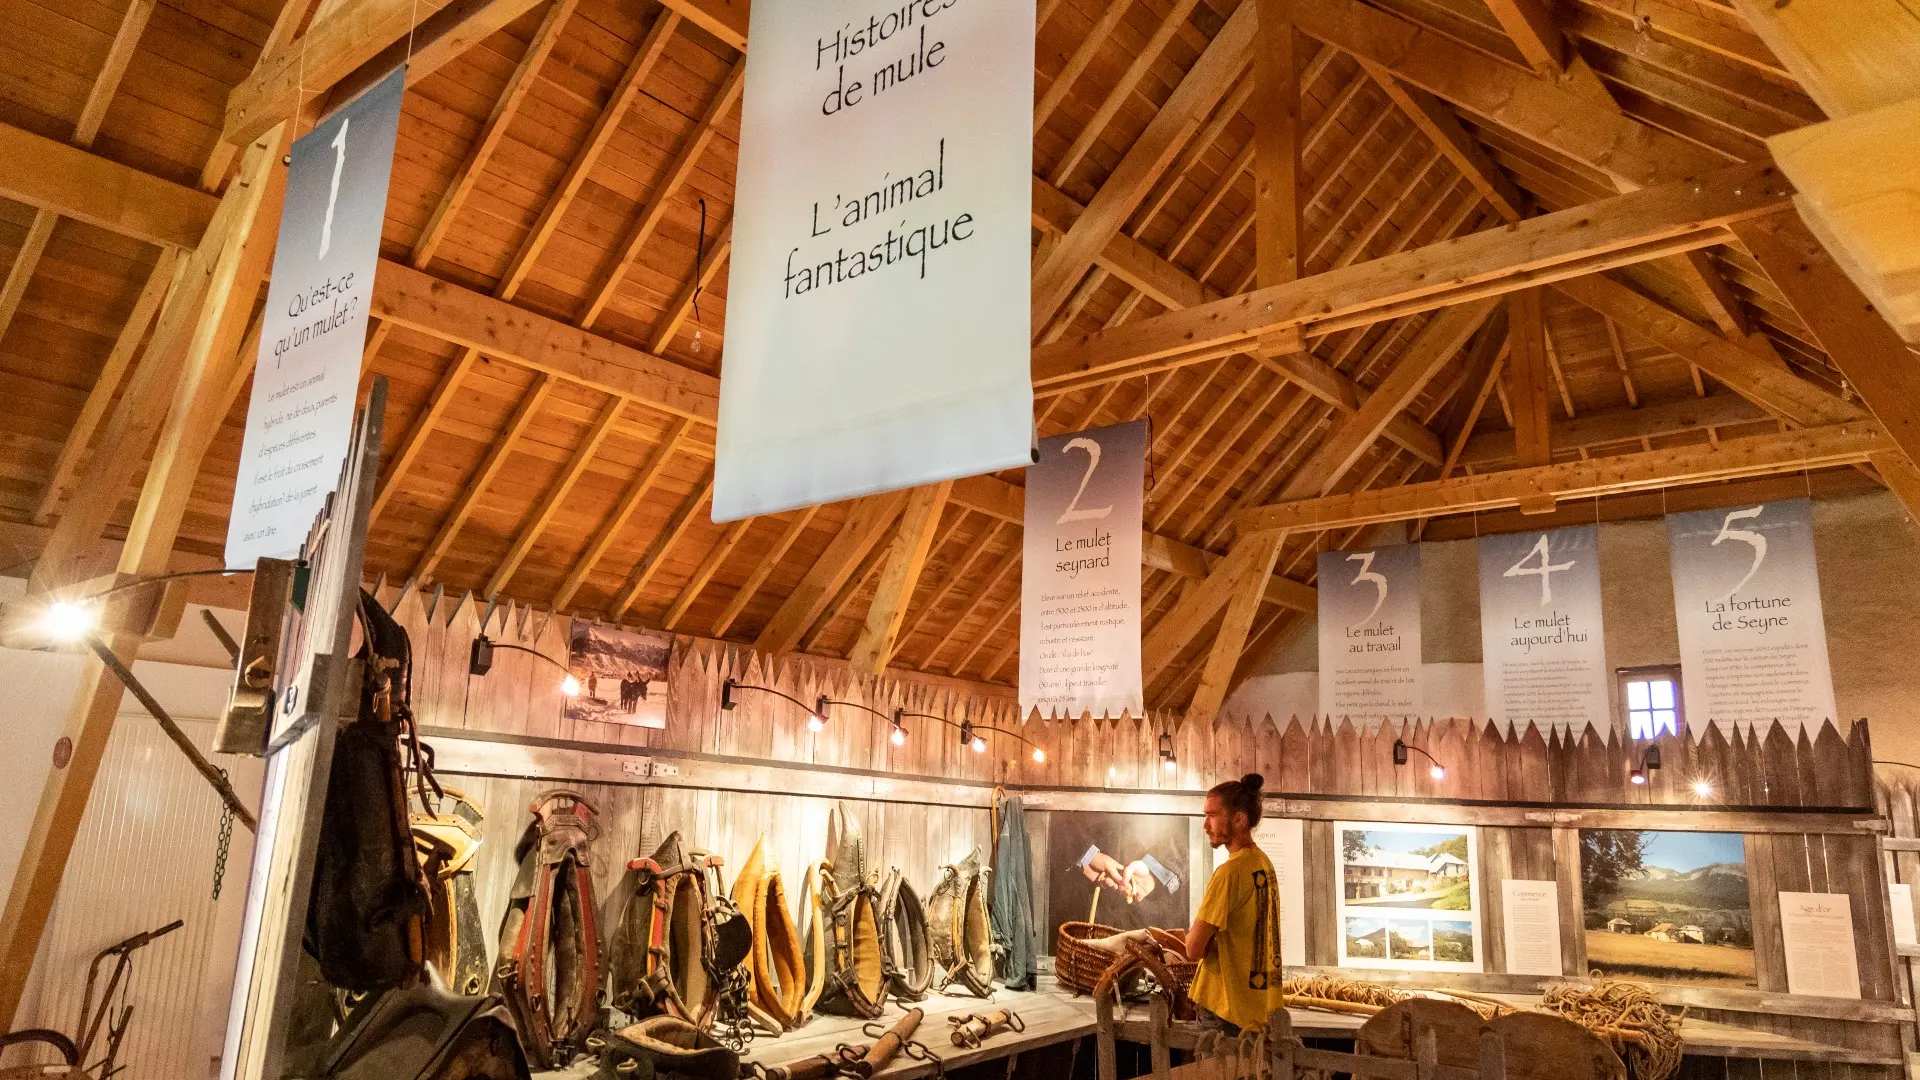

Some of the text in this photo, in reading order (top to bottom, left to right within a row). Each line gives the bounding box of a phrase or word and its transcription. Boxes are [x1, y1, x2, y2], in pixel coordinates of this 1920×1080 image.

[822, 24, 946, 116] de mule
[319, 117, 349, 261] 1
[811, 137, 945, 238] L'animal
[784, 212, 974, 299] fantastique
[288, 272, 354, 318] Qu'est-ce
[274, 326, 310, 369] qu'un
[1056, 437, 1114, 525] 2
[1056, 528, 1112, 552] Le mulet
[1711, 505, 1768, 601] 5
[1055, 547, 1110, 579] seynard
[1502, 534, 1576, 607] 4
[1345, 551, 1388, 627] 3
[1705, 593, 1792, 613] La fortune
[1346, 621, 1395, 638] Le mulet
[1510, 626, 1588, 655] aujourd'hui
[1514, 611, 1571, 629] Le mulet
[1712, 614, 1789, 635] de Seyne
[1349, 635, 1401, 653] au travail
